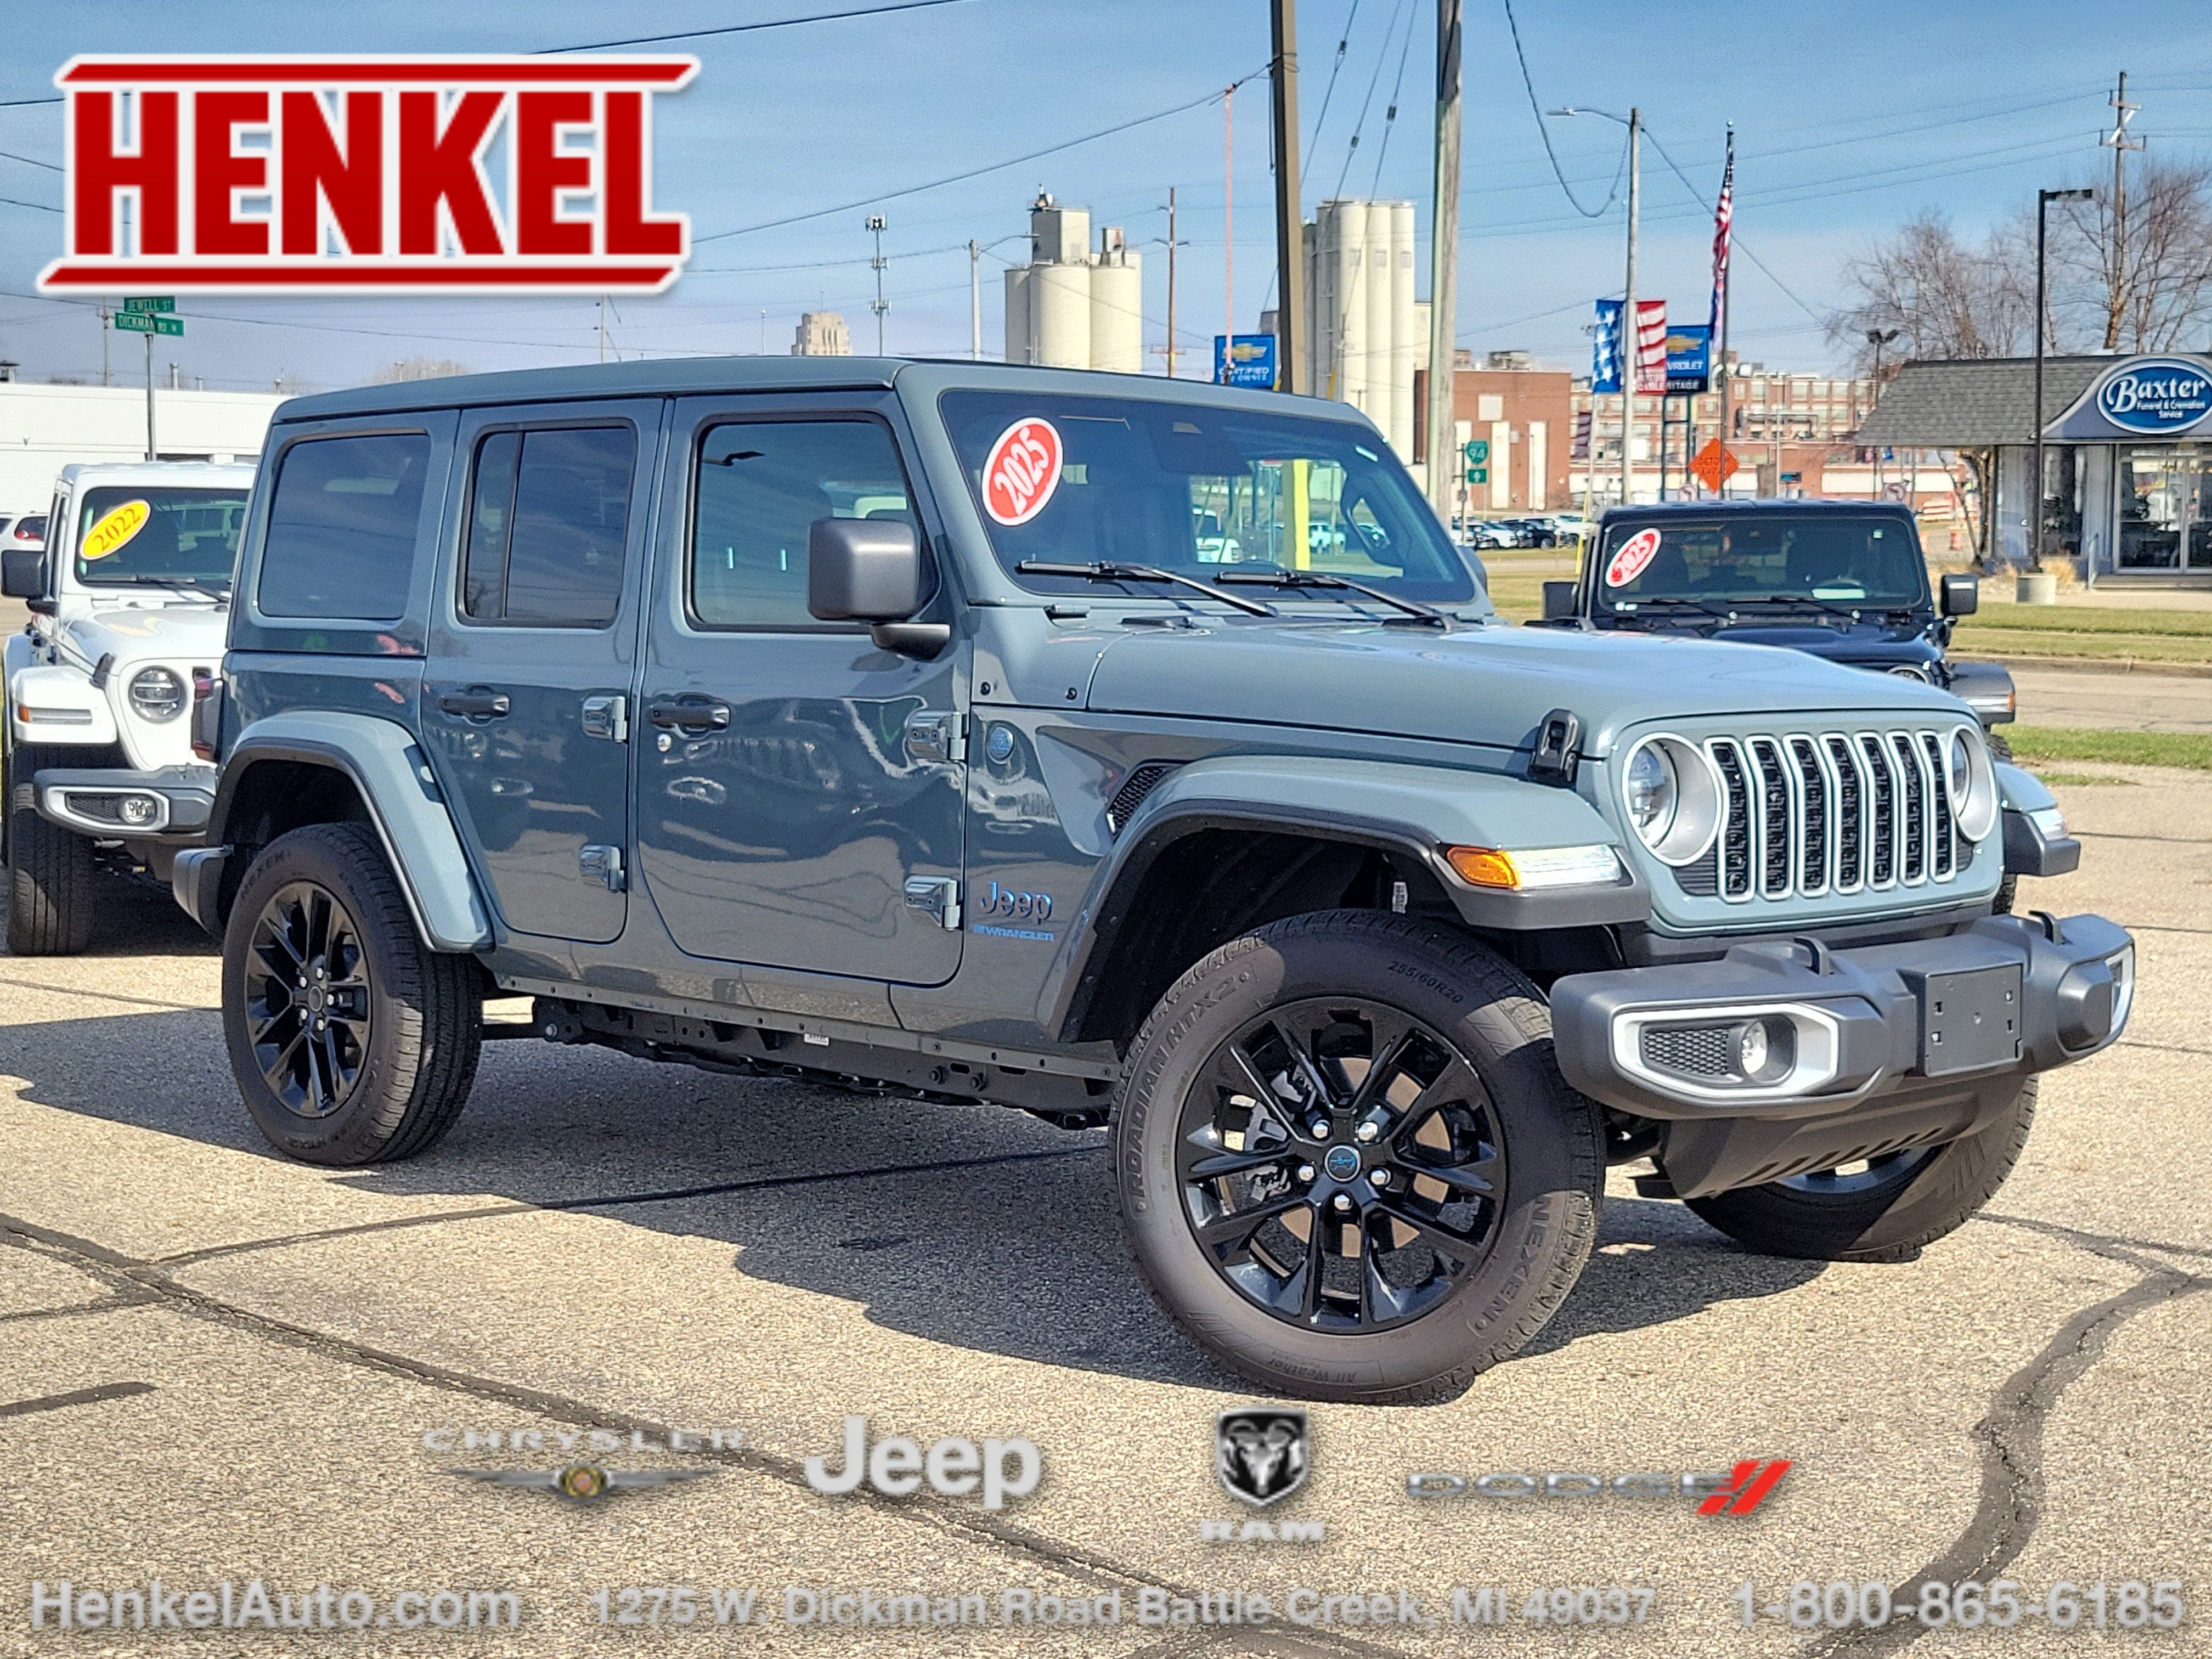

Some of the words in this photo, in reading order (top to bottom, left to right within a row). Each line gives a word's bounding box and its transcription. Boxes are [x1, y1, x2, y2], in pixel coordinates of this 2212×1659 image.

[126, 298, 160, 312] JEWELL
[163, 300, 171, 311] ST
[117, 315, 155, 330] DICKMAN
[1667, 359, 1703, 371] VROLET
[2106, 374, 2207, 413] Baxter
[2137, 399, 2162, 410] Funeral
[2170, 399, 2206, 409] Cremation
[2158, 410, 2183, 419] Service
[1469, 448, 1485, 460] 94
[1699, 457, 1730, 465] DETOR
[994, 426, 1049, 516] 2025
[93, 509, 141, 551] 2022
[1613, 538, 1652, 579] 2025
[980, 880, 1053, 925] Jeep
[985, 926, 1054, 942] WRANGLER
[1126, 1044, 1170, 1198] ROADIAN
[1482, 1194, 1552, 1323] NEXEN
